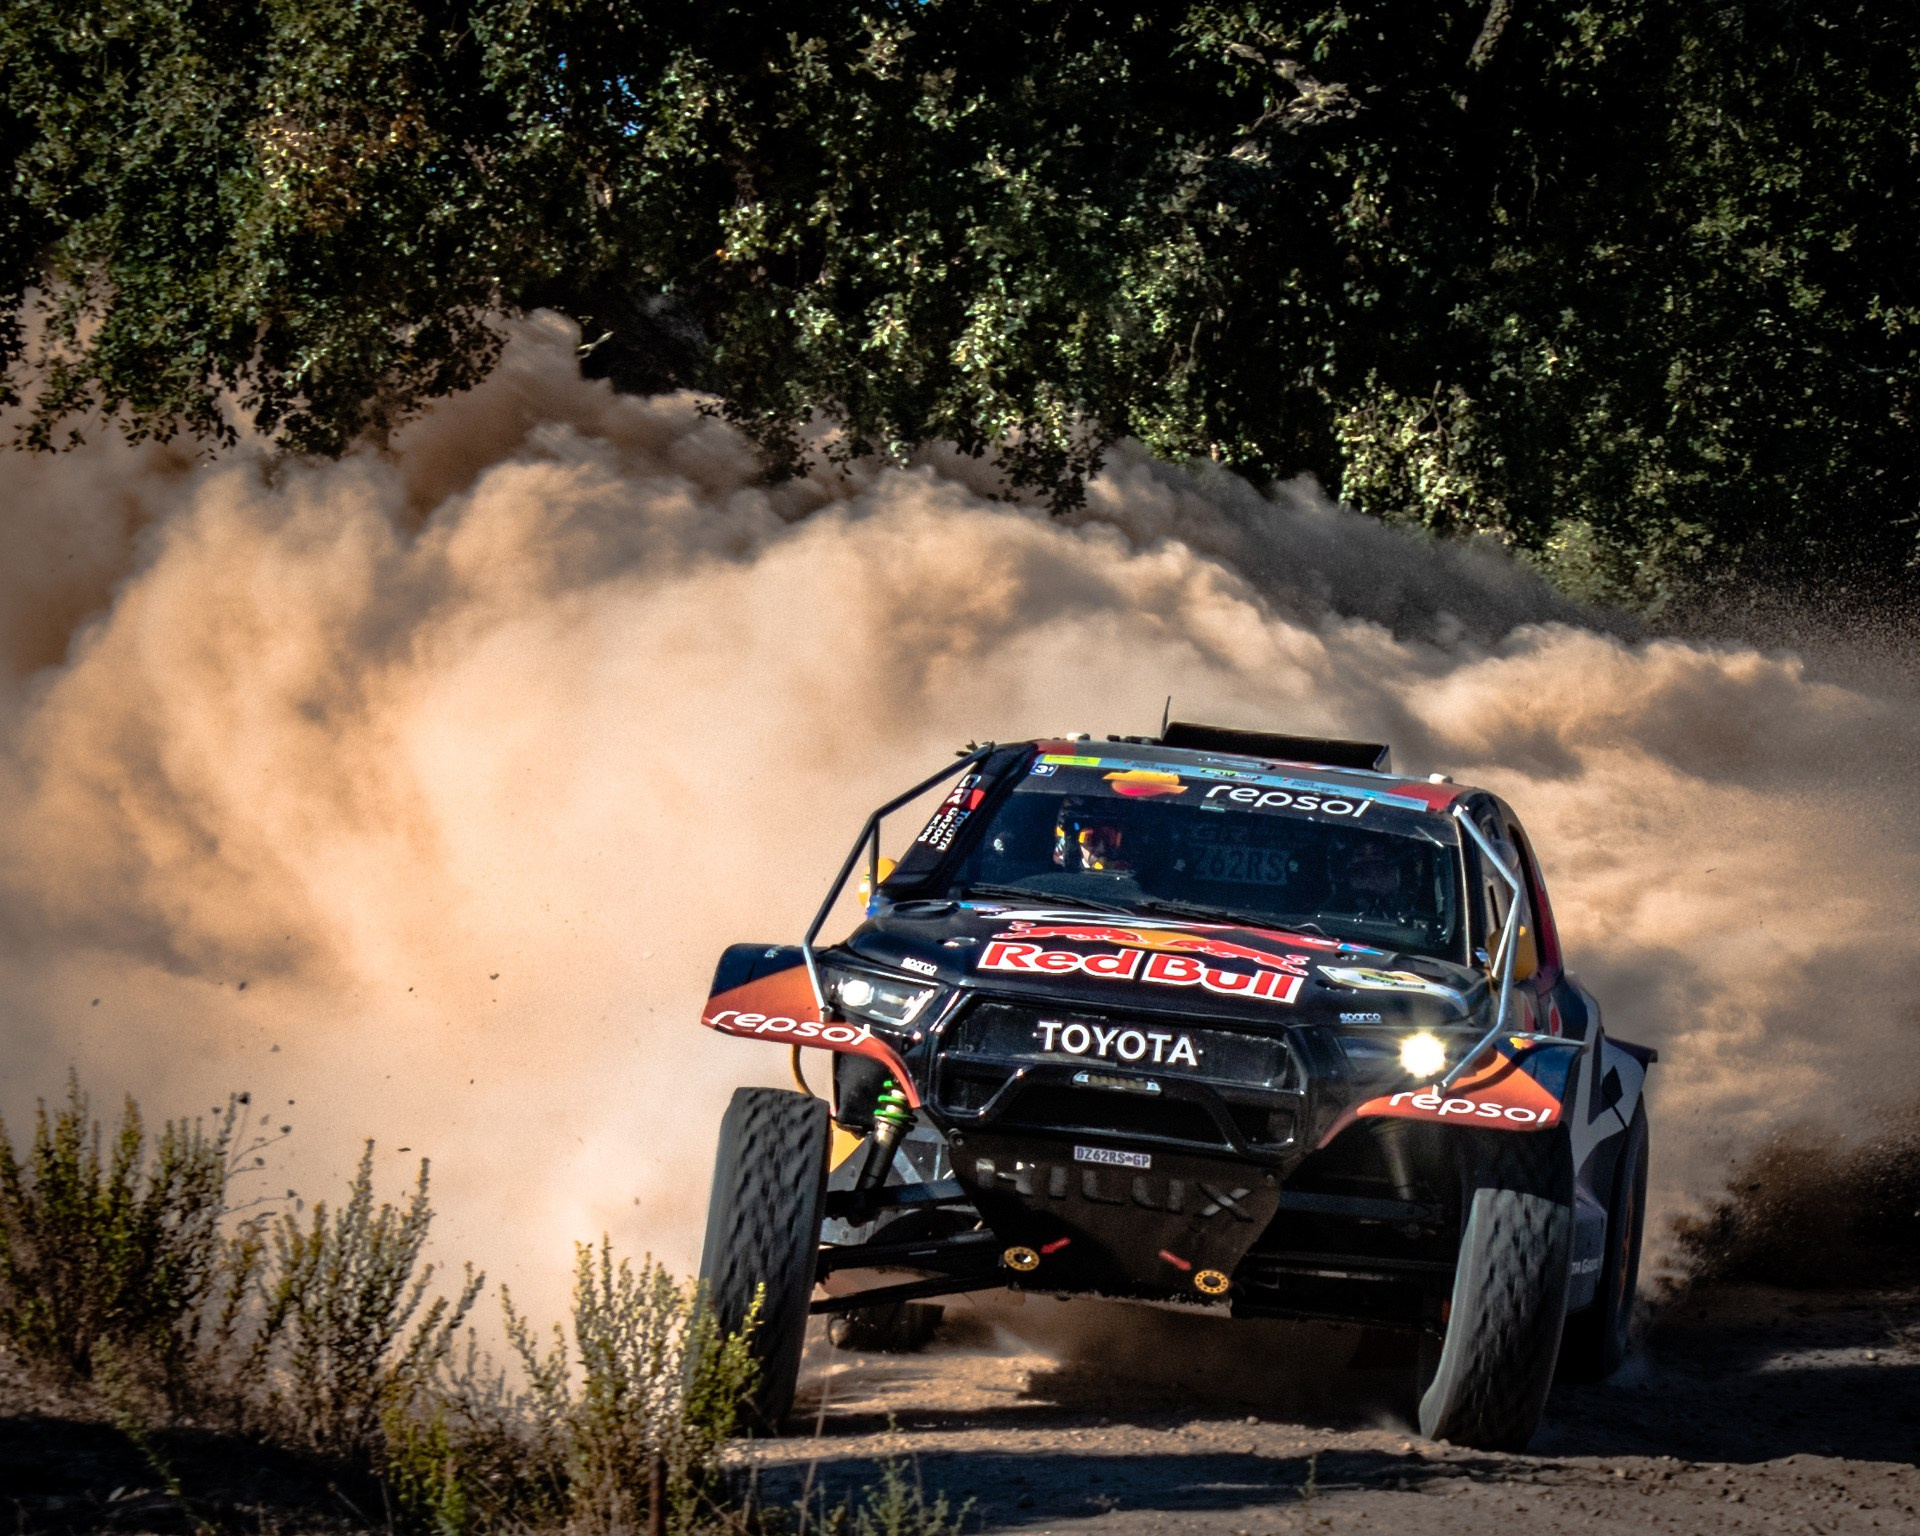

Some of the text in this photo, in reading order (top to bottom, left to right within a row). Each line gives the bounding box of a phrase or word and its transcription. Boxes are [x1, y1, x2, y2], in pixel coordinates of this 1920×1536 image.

[1206, 784, 1372, 818] repsol
[929, 807, 960, 845] GAZOO
[901, 957, 938, 976] sparco
[977, 941, 1305, 1004] Red Bull
[711, 1010, 869, 1046] repsol
[1339, 1012, 1381, 1023] sparco
[1037, 1020, 1198, 1066] TOYOTA
[1389, 1090, 1552, 1127] repsol
